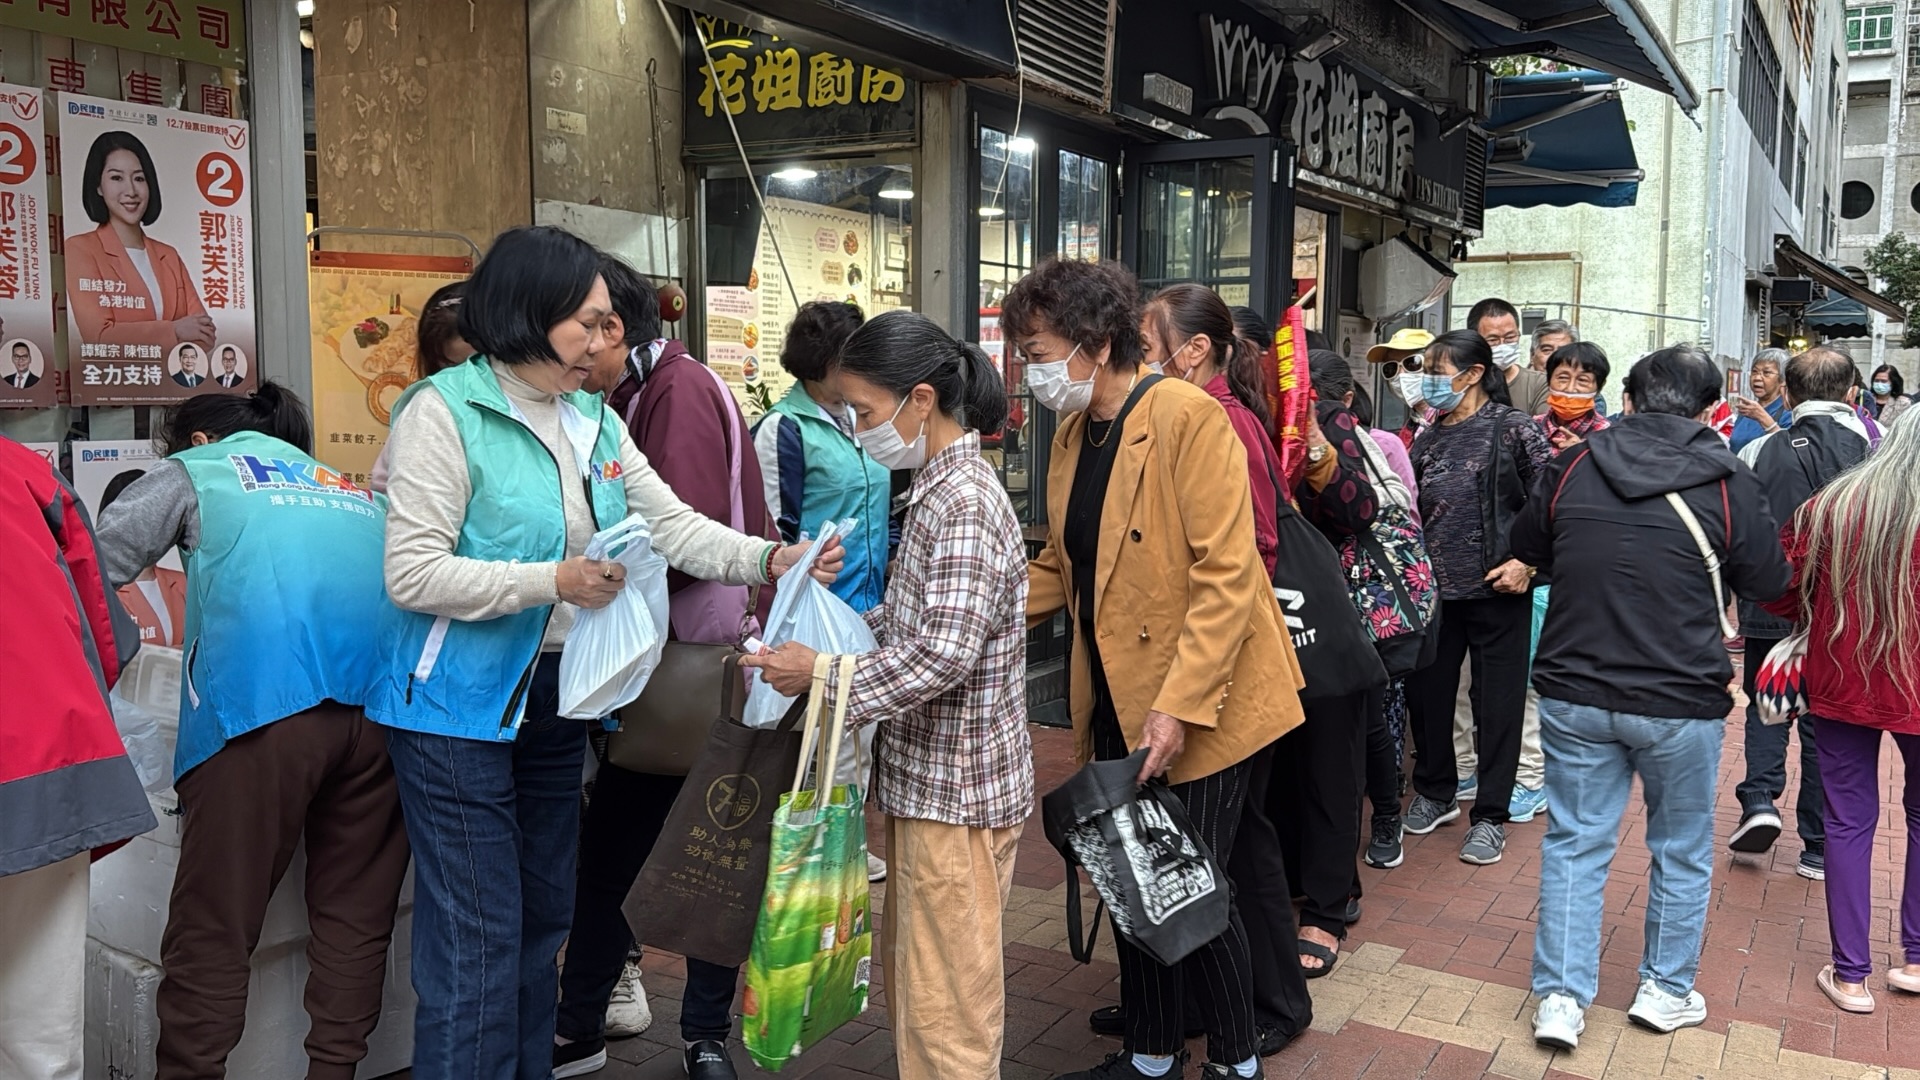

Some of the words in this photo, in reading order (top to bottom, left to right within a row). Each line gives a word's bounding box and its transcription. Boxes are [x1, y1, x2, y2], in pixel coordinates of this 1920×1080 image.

[166, 118, 229, 136] 12.7投票日請支持
[1291, 58, 1414, 199] 花姐廚房
[207, 159, 234, 198] 2
[28, 195, 37, 222] JODY
[29, 223, 38, 254] KWOK
[31, 256, 39, 271] FU
[199, 210, 229, 309] 郭芙蓉
[32, 273, 40, 300] YUNG
[79, 278, 127, 293] 團結發力
[238, 271, 245, 283] FU
[99, 295, 146, 309] 為港增值
[81, 344, 120, 358] 譚耀宗
[82, 363, 162, 386] 全力支持
[281, 483, 303, 491] Kong
[303, 485, 330, 494] Mutual
[270, 494, 326, 508] 攜手互助
[328, 499, 376, 519] 支援四方
[689, 825, 753, 851] 助人為樂
[684, 844, 750, 872] 功德無量
